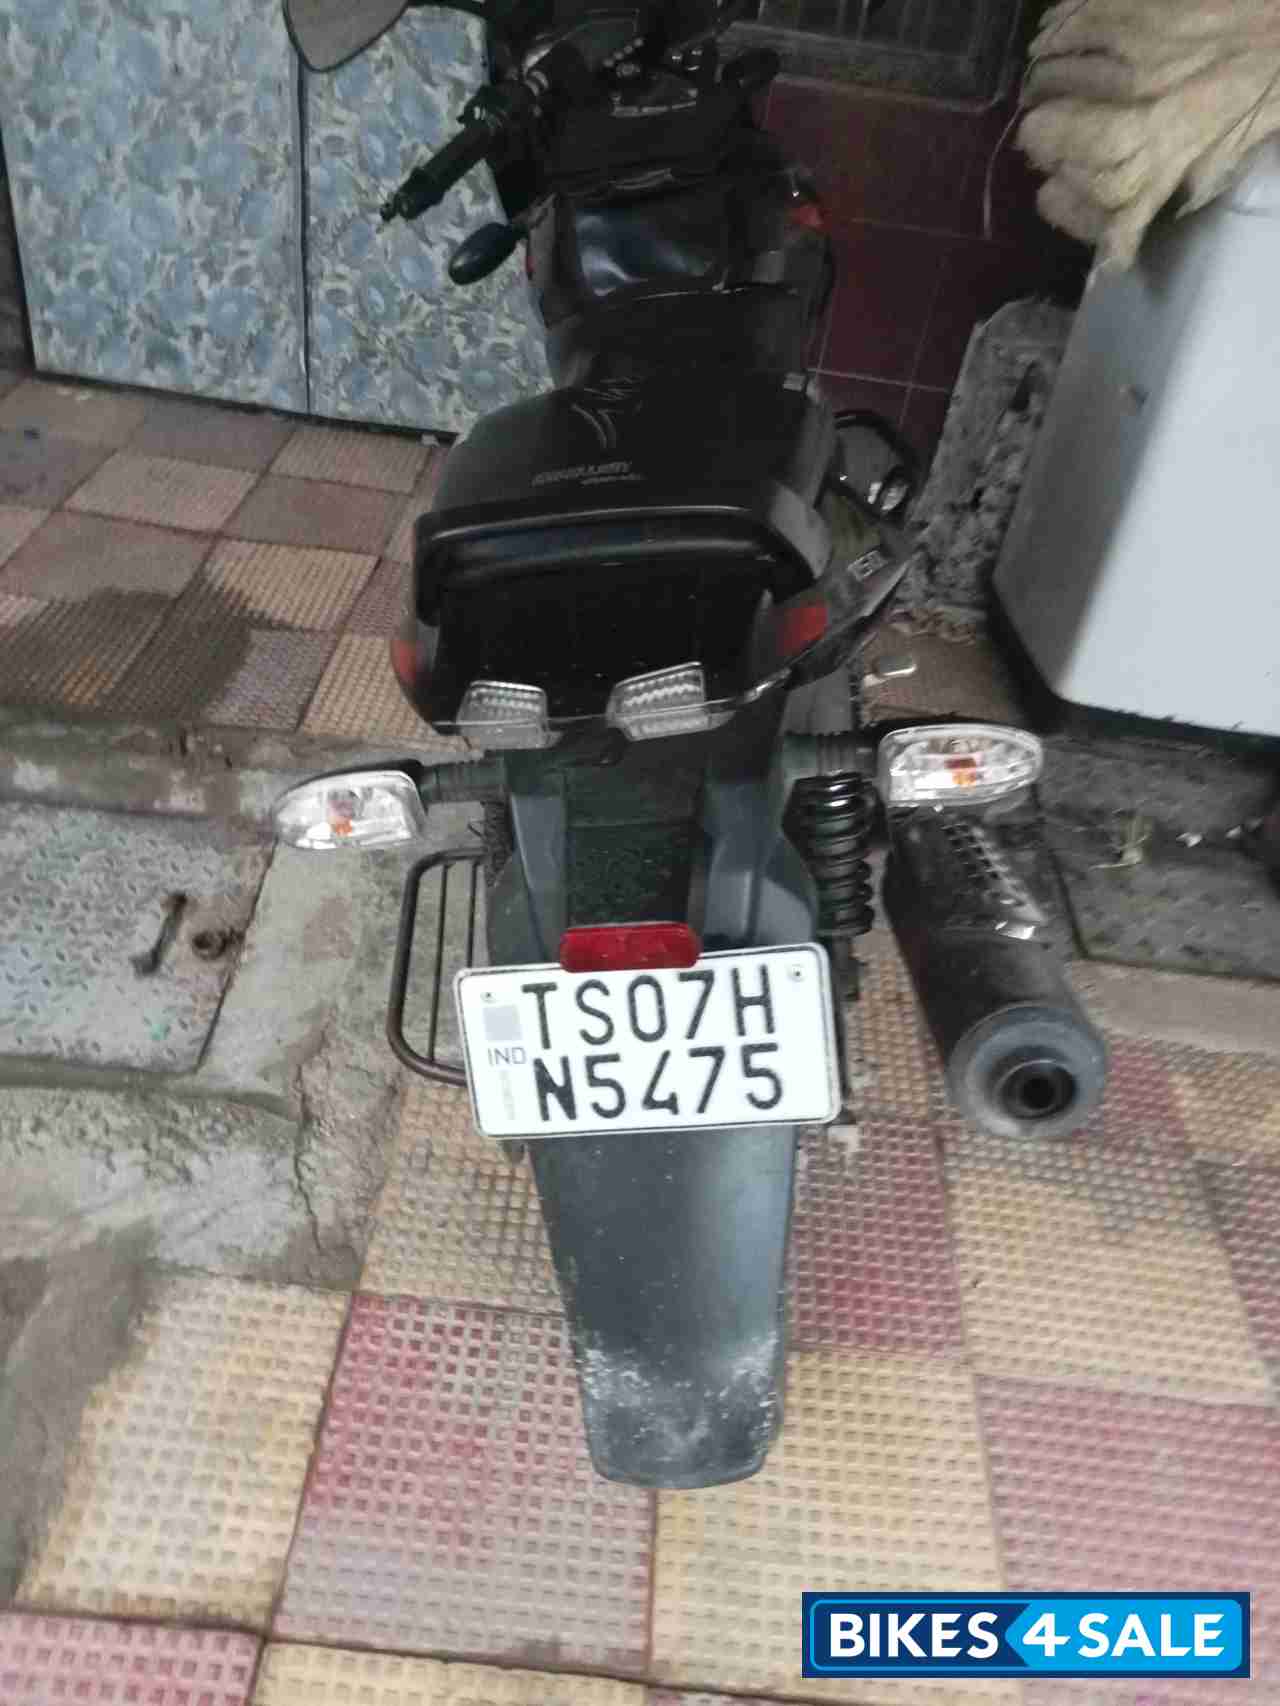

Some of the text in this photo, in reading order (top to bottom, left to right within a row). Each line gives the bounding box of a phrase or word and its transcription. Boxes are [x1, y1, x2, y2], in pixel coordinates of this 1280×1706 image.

[521, 963, 775, 1050] TS07H
[487, 1046, 527, 1067] IND
[533, 1042, 783, 1121] N5475
